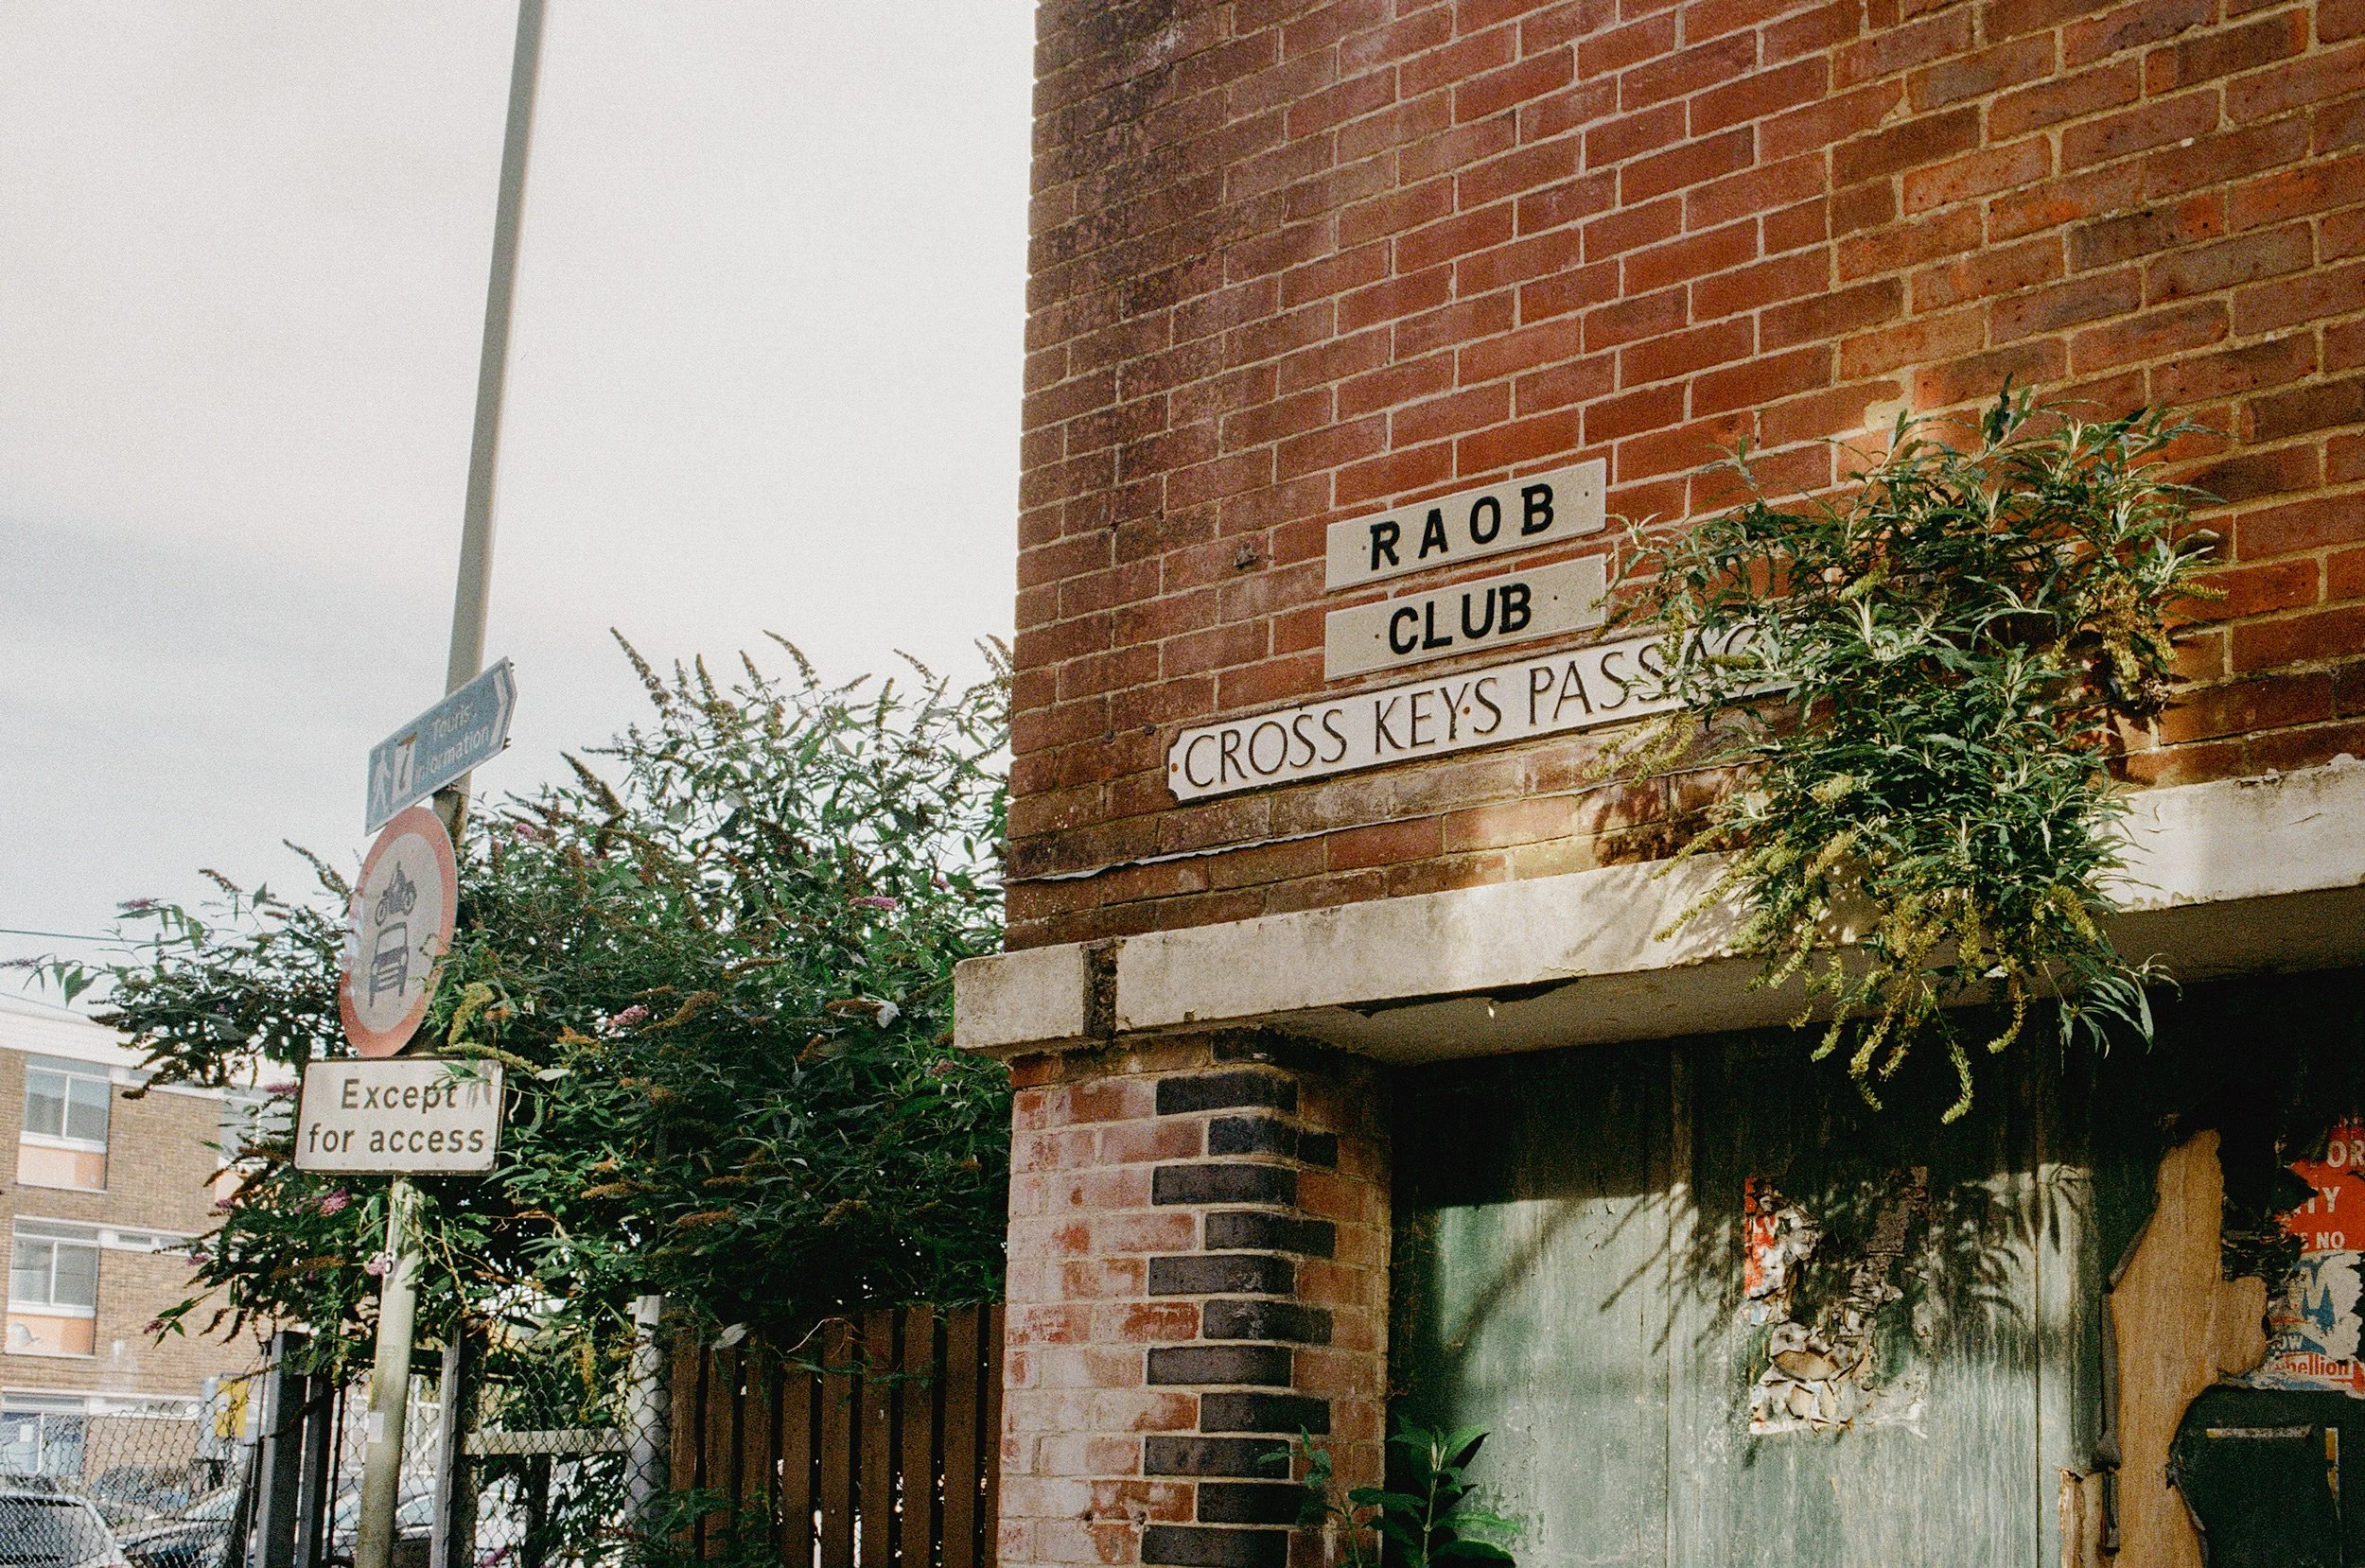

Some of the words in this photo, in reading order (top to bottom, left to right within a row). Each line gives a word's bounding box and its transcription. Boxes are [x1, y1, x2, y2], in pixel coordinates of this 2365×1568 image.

[1370, 483, 1553, 570] RAOB
[1388, 582, 1532, 654] CLUB
[1184, 708, 1348, 788] CROSS
[1375, 677, 1502, 755] KEYS
[341, 1078, 458, 1114] Except
[308, 1123, 356, 1153] for
[369, 1127, 484, 1153] access
[2316, 1230, 2346, 1249] NO
